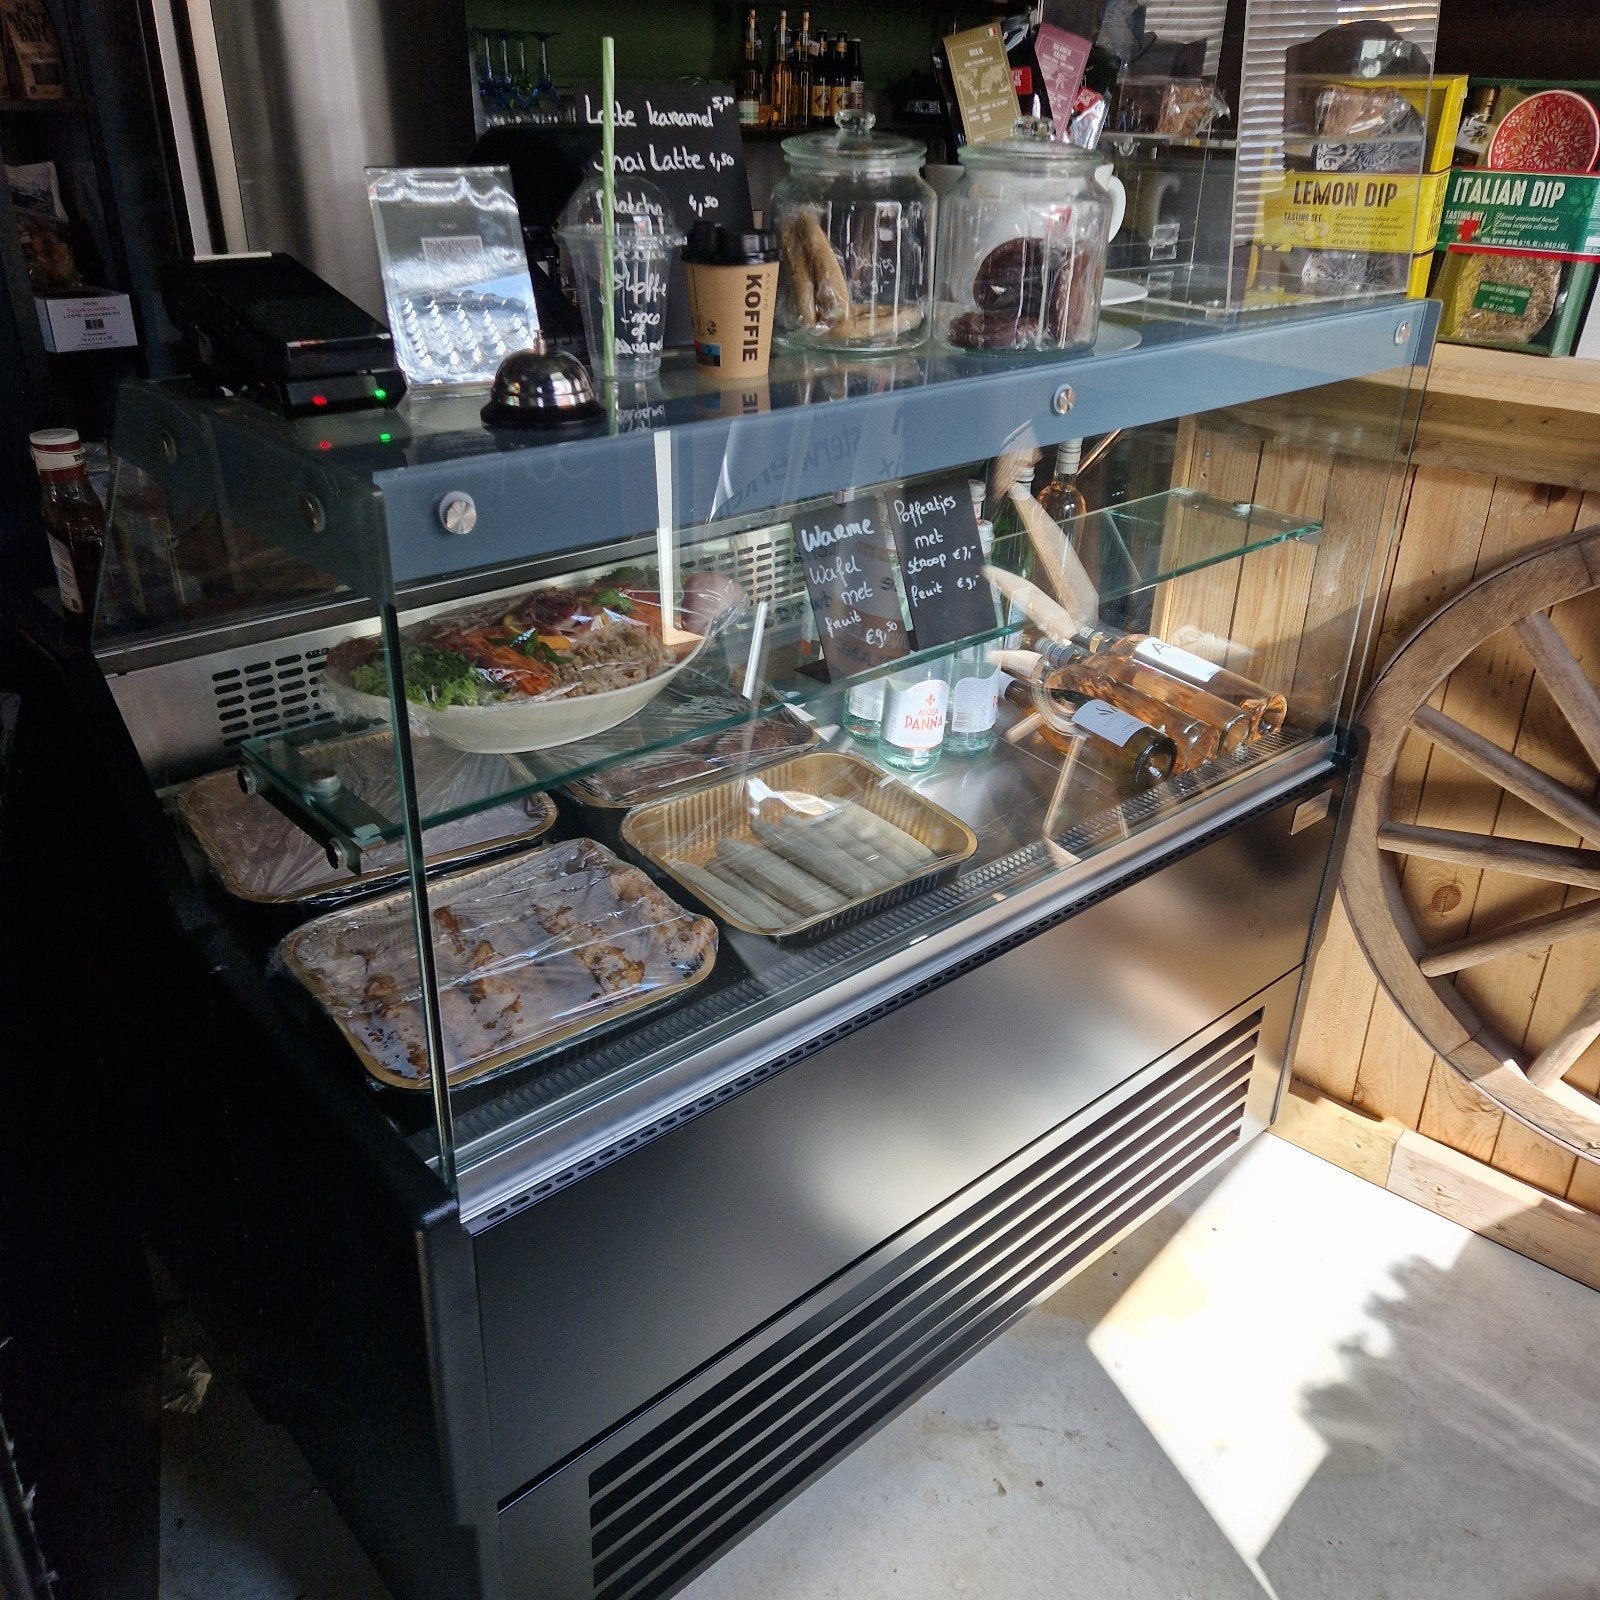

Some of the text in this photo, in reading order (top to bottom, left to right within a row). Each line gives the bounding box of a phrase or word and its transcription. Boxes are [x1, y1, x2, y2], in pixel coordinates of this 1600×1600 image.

[645, 100, 715, 127] karamel
[648, 143, 706, 172] Latte
[688, 193, 719, 218] 4,50
[1293, 180, 1399, 208] LEMON DIP
[1452, 177, 1566, 208] ITALIAN DIP
[1311, 213, 1323, 223] SET
[742, 273, 763, 362] KOFFIE
[893, 494, 957, 527] Poffertjes
[801, 518, 876, 552] Warme
[914, 528, 944, 549] met
[809, 555, 862, 586] Wafel
[907, 553, 948, 575] stroop
[841, 581, 873, 605] met
[911, 580, 943, 607] fruit
[824, 609, 862, 638] fruit
[904, 715, 944, 731] PANNA
